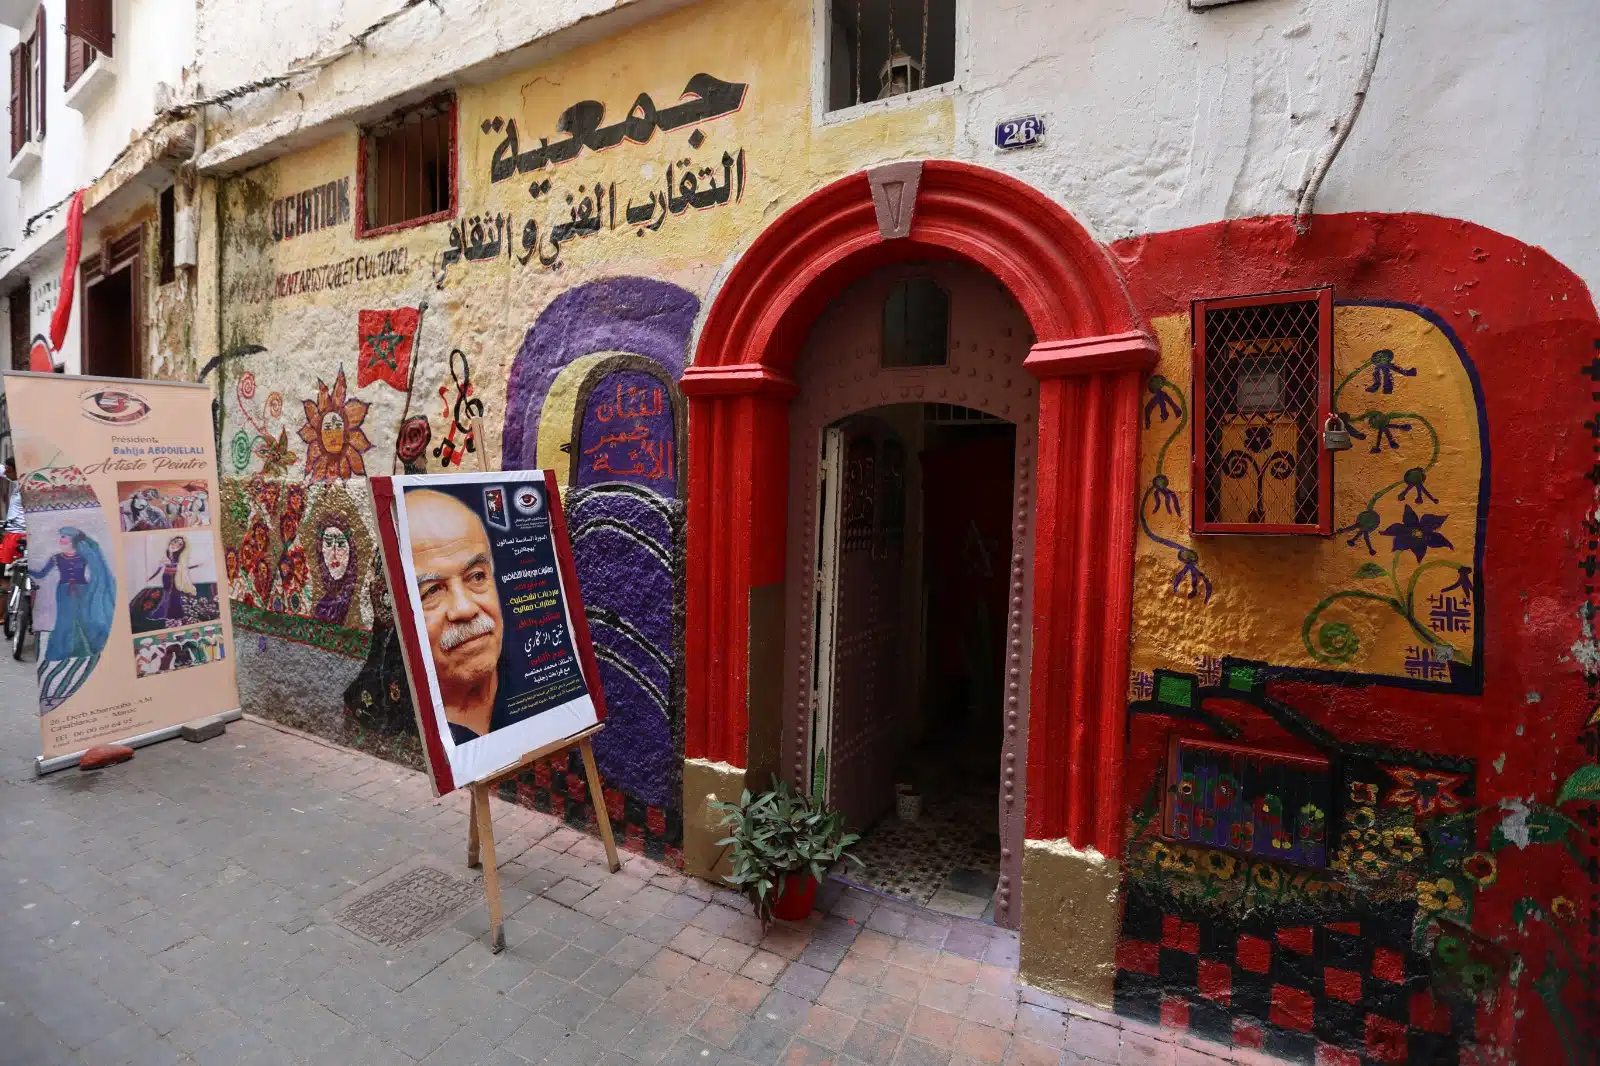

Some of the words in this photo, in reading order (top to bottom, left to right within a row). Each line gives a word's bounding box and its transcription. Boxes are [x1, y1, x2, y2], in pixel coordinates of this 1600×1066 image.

[481, 73, 749, 198] جمعية
[1003, 119, 1036, 146] 26
[626, 146, 747, 237] التقارب
[356, 247, 409, 281] CULTUREL
[113, 446, 145, 456] Bahija
[83, 457, 147, 474] Artiste
[152, 456, 208, 474] Peintre
[50, 717, 97, 733] Casablanca
